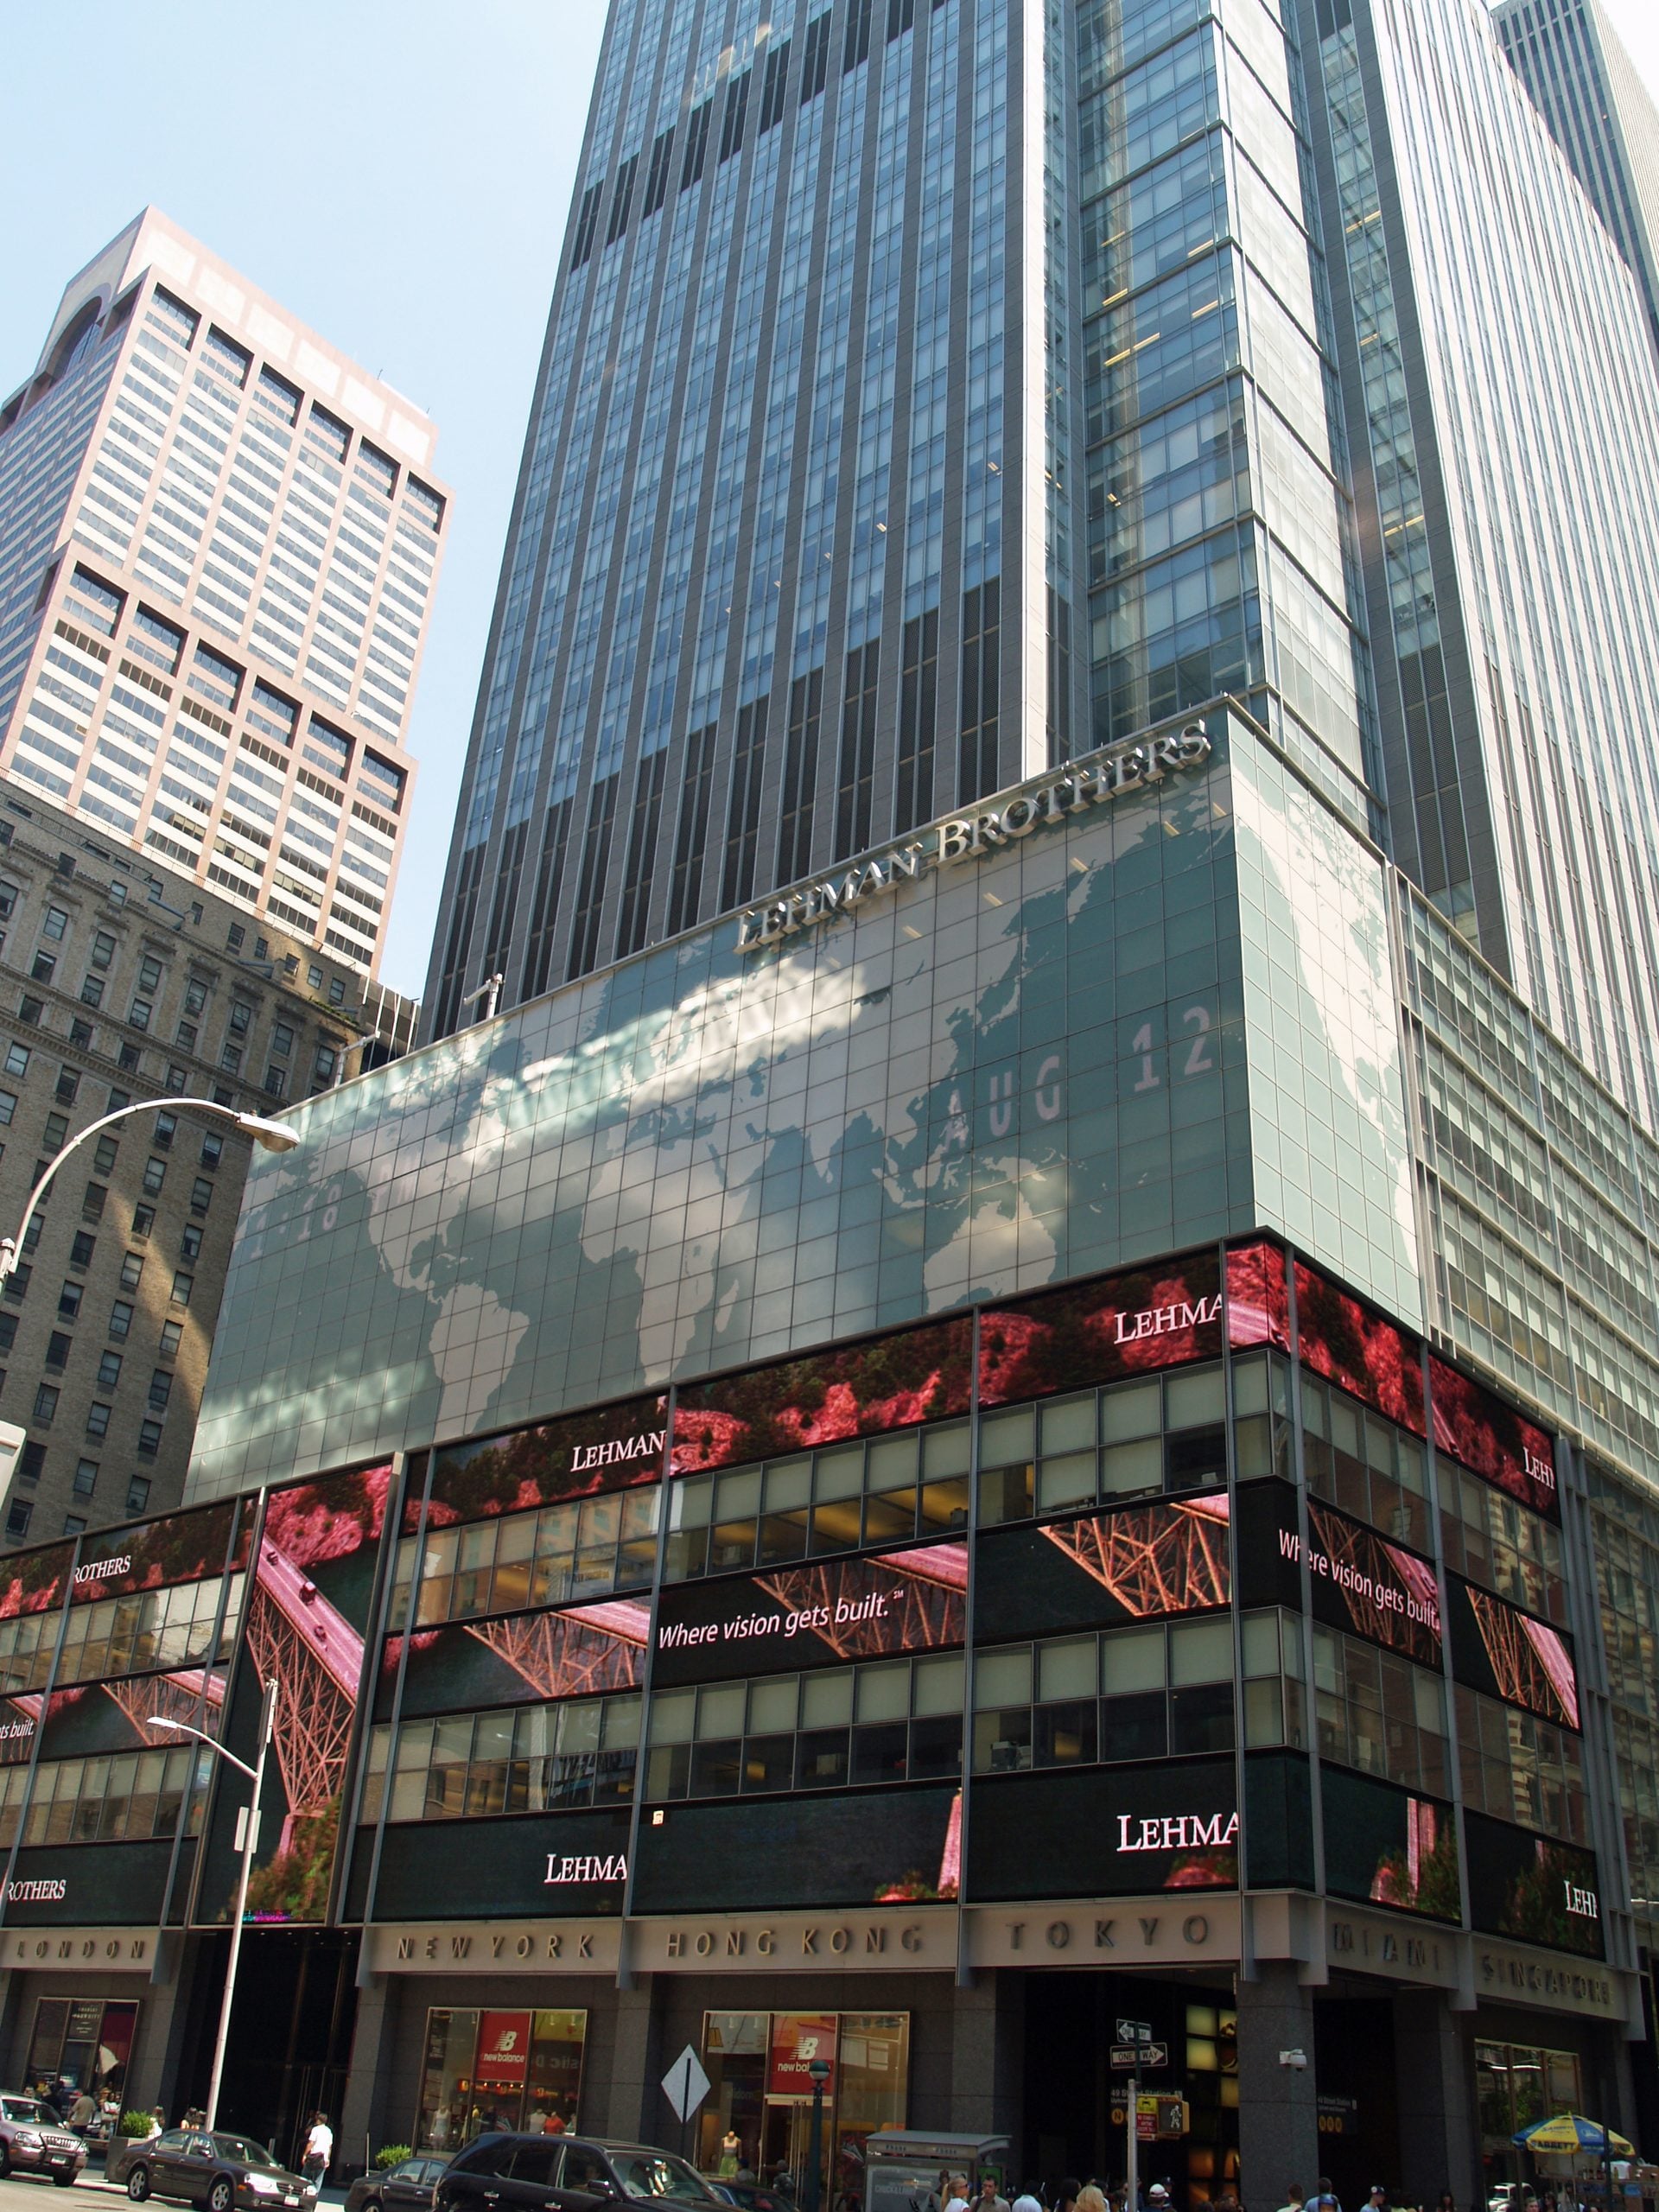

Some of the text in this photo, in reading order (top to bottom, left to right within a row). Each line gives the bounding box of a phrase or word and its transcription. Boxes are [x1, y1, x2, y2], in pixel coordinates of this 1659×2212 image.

[734, 718, 1213, 955] LEHMAN BROTHERS
[939, 1006, 1213, 1149] AUG 12
[570, 1429, 666, 1472] LEHMAN
[1332, 1559, 1372, 1599] vision
[1376, 1582, 1404, 1611] gets
[658, 1622, 718, 1649] Where
[723, 1611, 779, 1639] vision
[785, 1605, 830, 1637] gets
[835, 1592, 889, 1624] built.
[10, 1717, 34, 1738] built.
[17, 1940, 145, 1959] LONDON
[397, 1934, 594, 1959] NEW YORK
[666, 1925, 921, 1957] HONG KONG
[1005, 1915, 1210, 1950] TOKYO
[1332, 1921, 1440, 1971] MIAMI
[1482, 1954, 1616, 2005] SINGAPORE
[483, 2052, 525, 2063] new balance
[778, 2063, 795, 2072] new
[1119, 2050, 1159, 2062] ONE WAY
